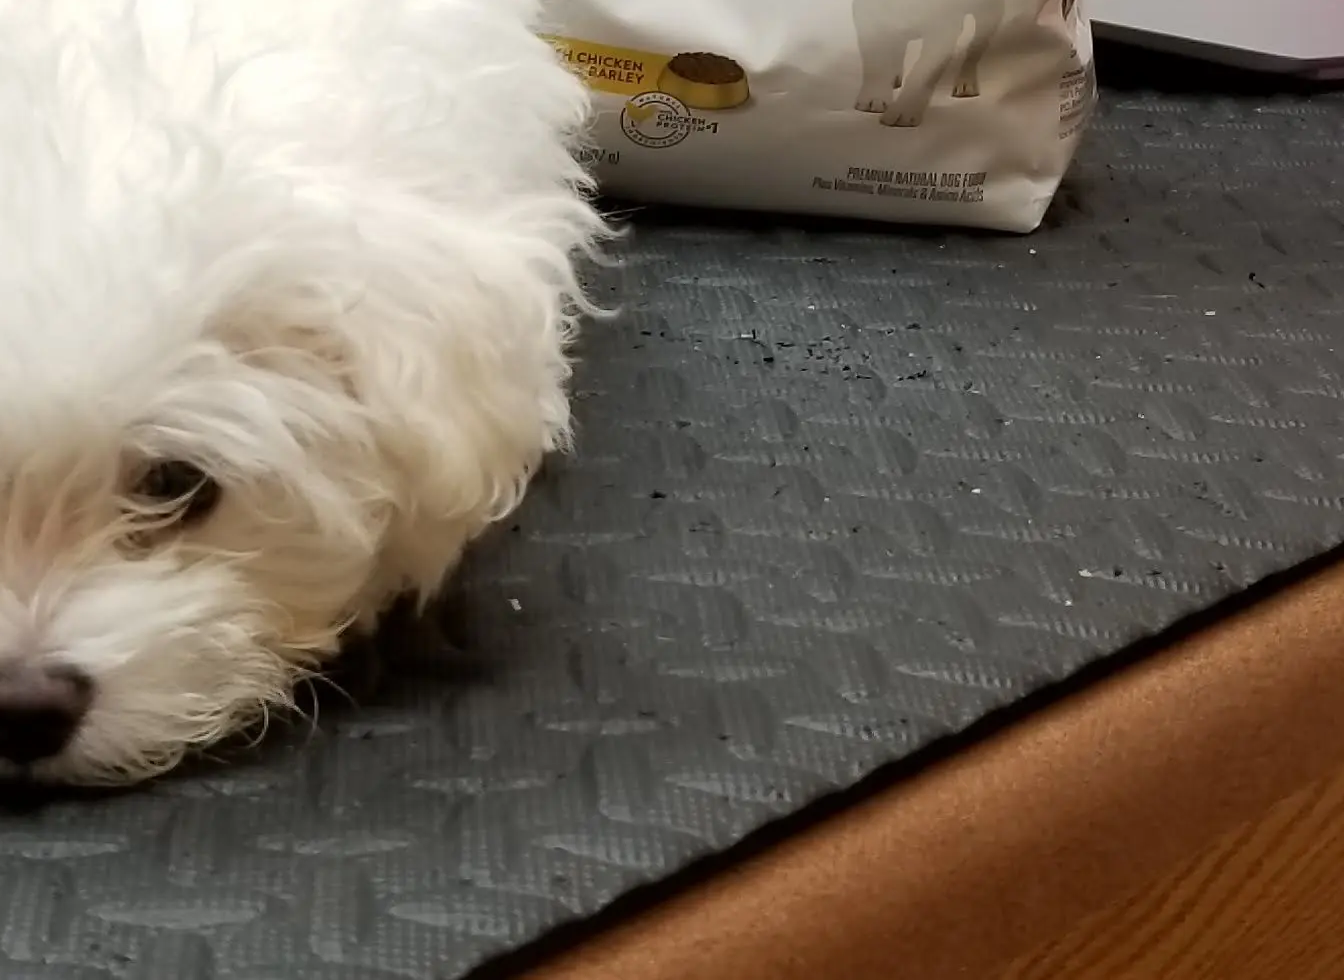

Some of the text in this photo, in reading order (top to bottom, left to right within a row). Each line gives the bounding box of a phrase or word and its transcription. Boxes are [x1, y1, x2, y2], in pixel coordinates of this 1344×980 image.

[576, 51, 644, 72] CHICKEN
[588, 65, 645, 85] BARLEY
[657, 113, 706, 126] CHICKEN
[846, 167, 894, 184] PREMIUM
[896, 170, 937, 188] NATURAL
[963, 172, 987, 186] FOOD
[812, 177, 832, 190] Plus
[928, 188, 958, 202] Amino
[959, 189, 984, 203] Acids
